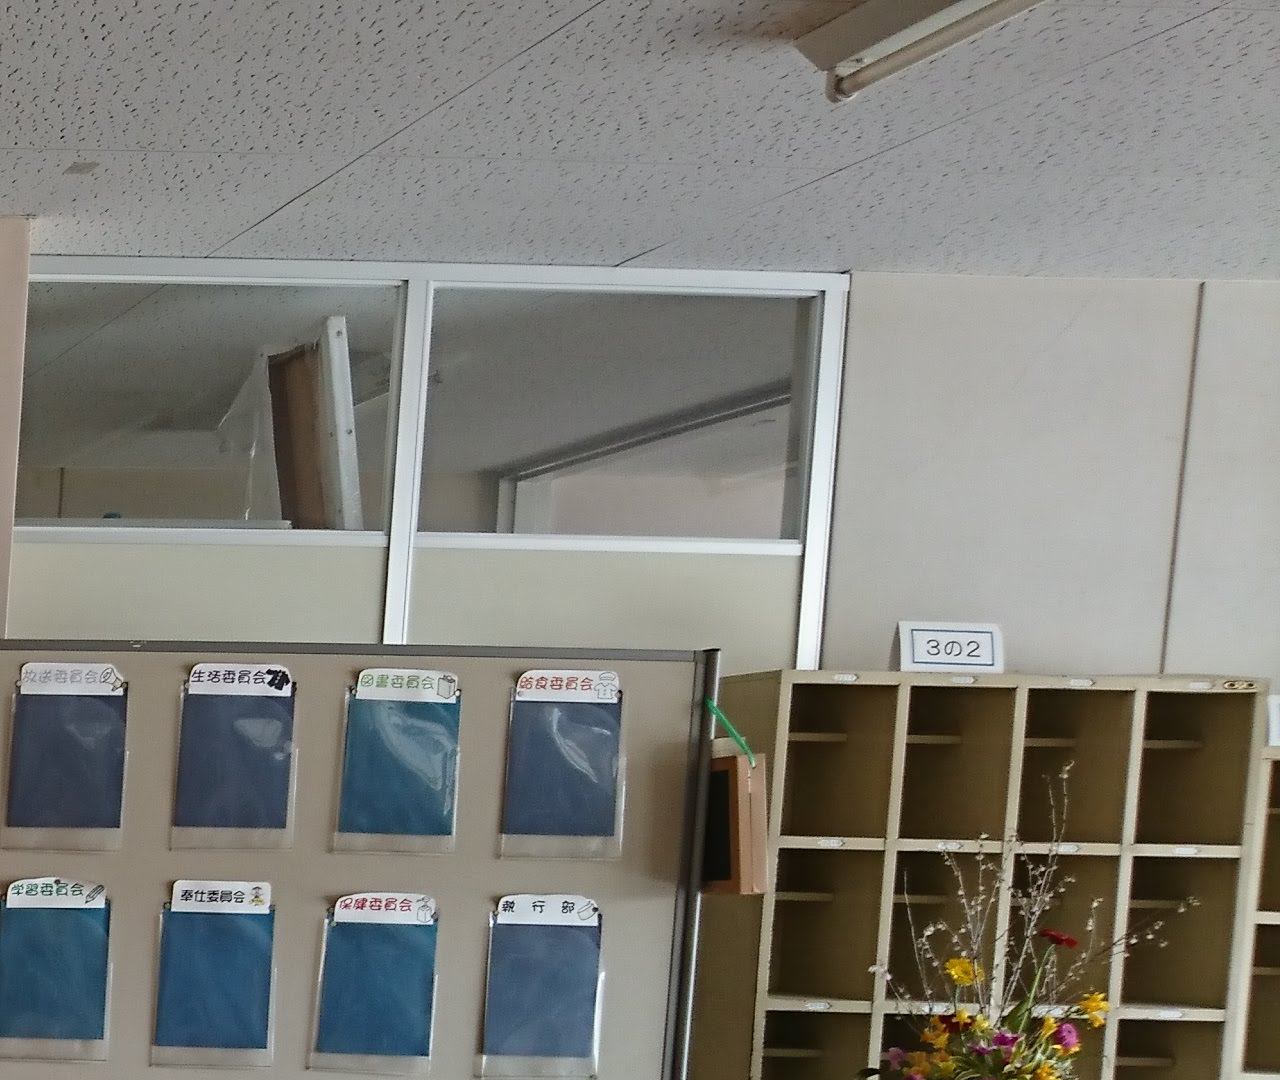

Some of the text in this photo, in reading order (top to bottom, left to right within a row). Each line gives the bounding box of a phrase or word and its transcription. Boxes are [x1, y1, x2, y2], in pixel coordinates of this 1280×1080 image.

[926, 639, 981, 658] 3の2
[23, 668, 100, 684] 放送委員会
[191, 669, 267, 685] 生活委員会
[360, 674, 436, 690] 図書委員会
[519, 676, 594, 691] 給食委員会
[11, 882, 85, 897] 学習委員会
[179, 889, 246, 903] 奉仕委員会
[339, 897, 414, 912] 保健委員会
